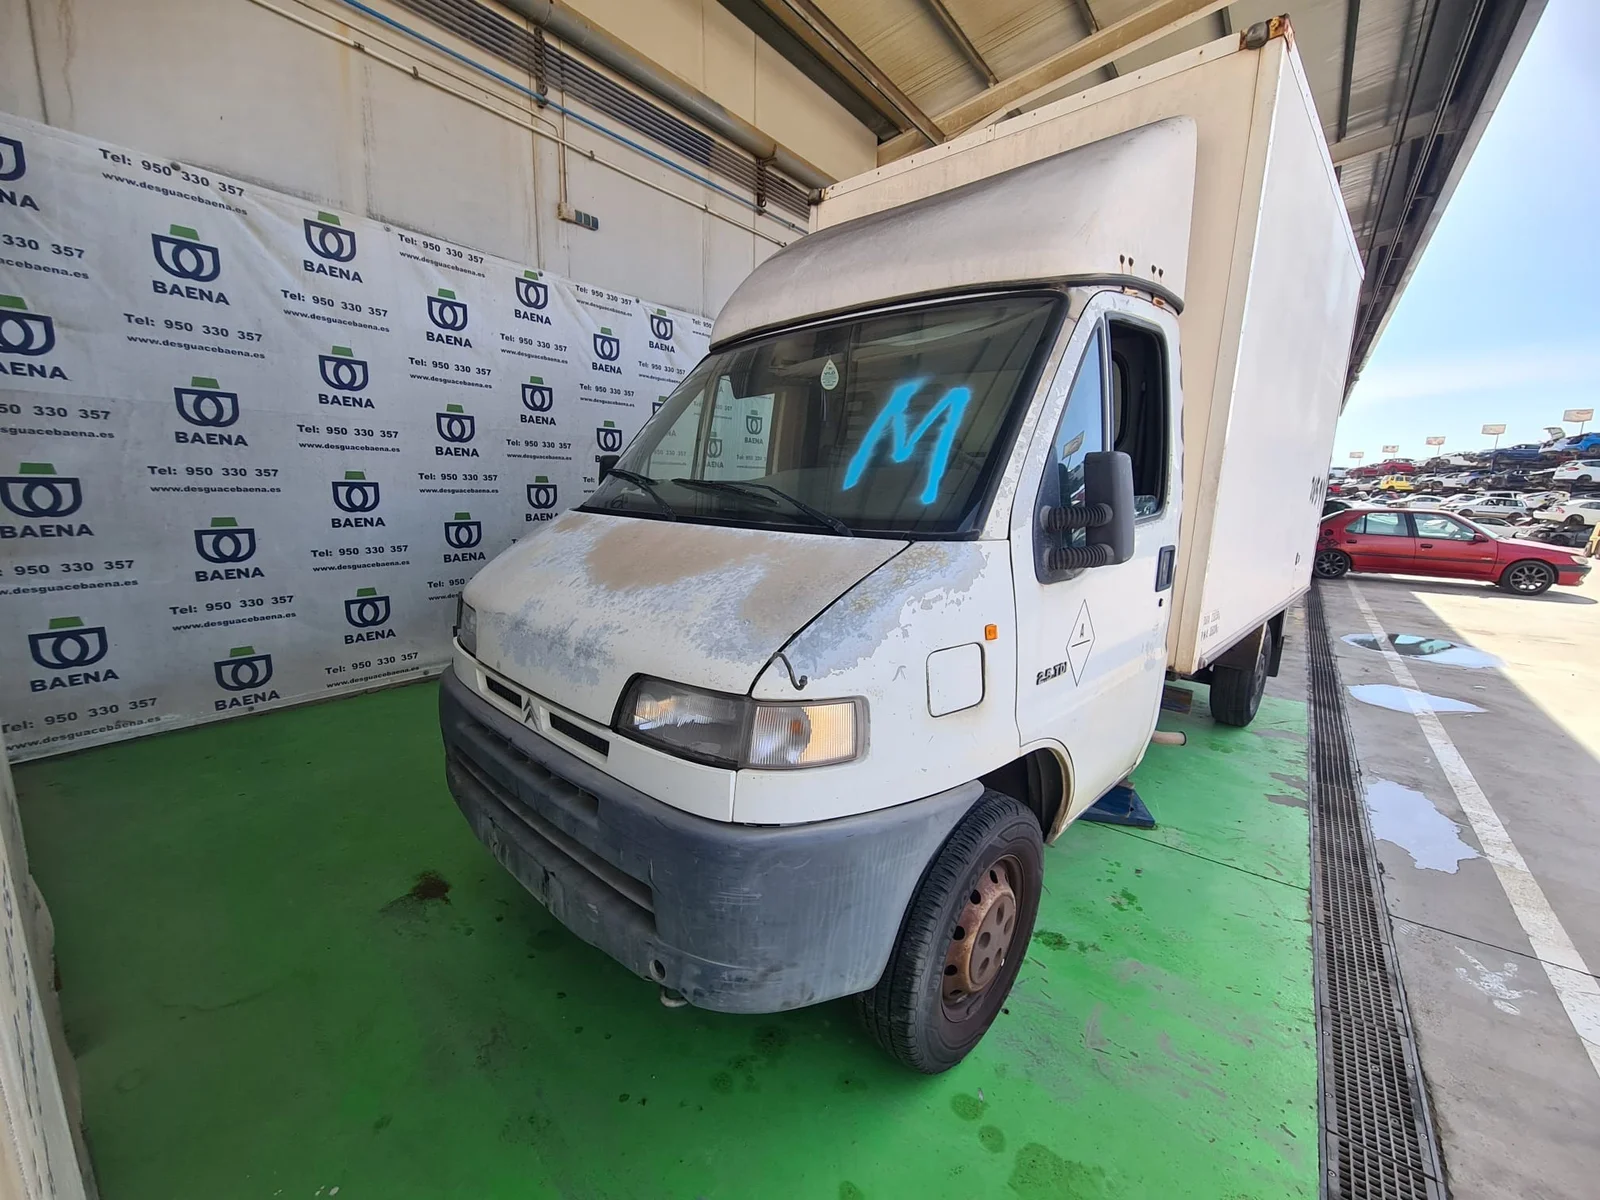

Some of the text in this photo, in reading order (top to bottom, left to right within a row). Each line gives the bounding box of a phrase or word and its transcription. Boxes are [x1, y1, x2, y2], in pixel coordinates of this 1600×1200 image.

[98, 148, 244, 197] Tel: 950 330 357
[101, 171, 248, 216] www.desguacebaena.es
[2, 234, 85, 259] 330 357
[398, 233, 484, 264] Tel: 950 330 357
[303, 259, 363, 283] BAENA
[399, 251, 486, 279] www.desguacebaena.es
[152, 280, 230, 306] BAENA
[575, 284, 632, 305] Tel: 950 330 357
[281, 289, 388, 318] Tel: 950 330 357
[282, 307, 390, 333] www.desguacebaena.es
[514, 309, 552, 326] BAENA
[123, 313, 262, 342] Tel: 950 330 357
[127, 335, 266, 359] www.desguacebaena.es
[426, 331, 472, 348] BAENA
[500, 333, 567, 352] Tel: 950 330 357
[649, 340, 675, 353] BAENA
[408, 357, 491, 376] Tel: 950 330 357
[592, 362, 622, 375] BAENA
[638, 360, 649, 369] Tel:
[651, 363, 662, 371] 950
[409, 372, 493, 390] www.desguacebaena.es
[579, 383, 635, 397] Tel: 950 330 357
[318, 393, 375, 409] BAENA
[33, 405, 68, 418] 330
[78, 409, 111, 420] 357
[520, 414, 556, 426] BAENA
[175, 431, 248, 447] BAENA
[296, 424, 398, 438] Tel: 950 330 357
[842, 375, 972, 504] M
[298, 441, 401, 453] www.desguacebaena.es
[435, 446, 479, 457] BAENA
[147, 466, 279, 477] Tel: 950 330 357
[418, 473, 436, 481] Tel:
[440, 473, 458, 481] 950
[149, 485, 282, 495] www.desguacebaena.es
[419, 487, 500, 495] www.desguacebaena.es
[0, 523, 94, 539] BAENA
[331, 517, 386, 528] BAENA
[310, 545, 408, 558] Tel: 950 330 357
[443, 551, 486, 563] BAENA
[14, 564, 50, 576] 950
[60, 562, 94, 573] 330
[104, 560, 135, 570] 357
[195, 567, 265, 582] BAENA
[312, 559, 411, 573] www.desguacebaena.es
[427, 580, 444, 588] Tel:
[449, 578, 465, 587] 950
[169, 595, 294, 616] Tel: 950 330 357
[172, 611, 297, 632] www.desguacebaena.es
[344, 629, 396, 645] BAENA
[325, 652, 419, 675] Tel: 950 330 357
[30, 669, 120, 693] BAENA
[326, 666, 420, 689] www.desguacebaena.es
[214, 690, 281, 712] BAENA
[44, 711, 78, 726] 950
[87, 704, 119, 718] 330
[128, 697, 158, 711] 357
